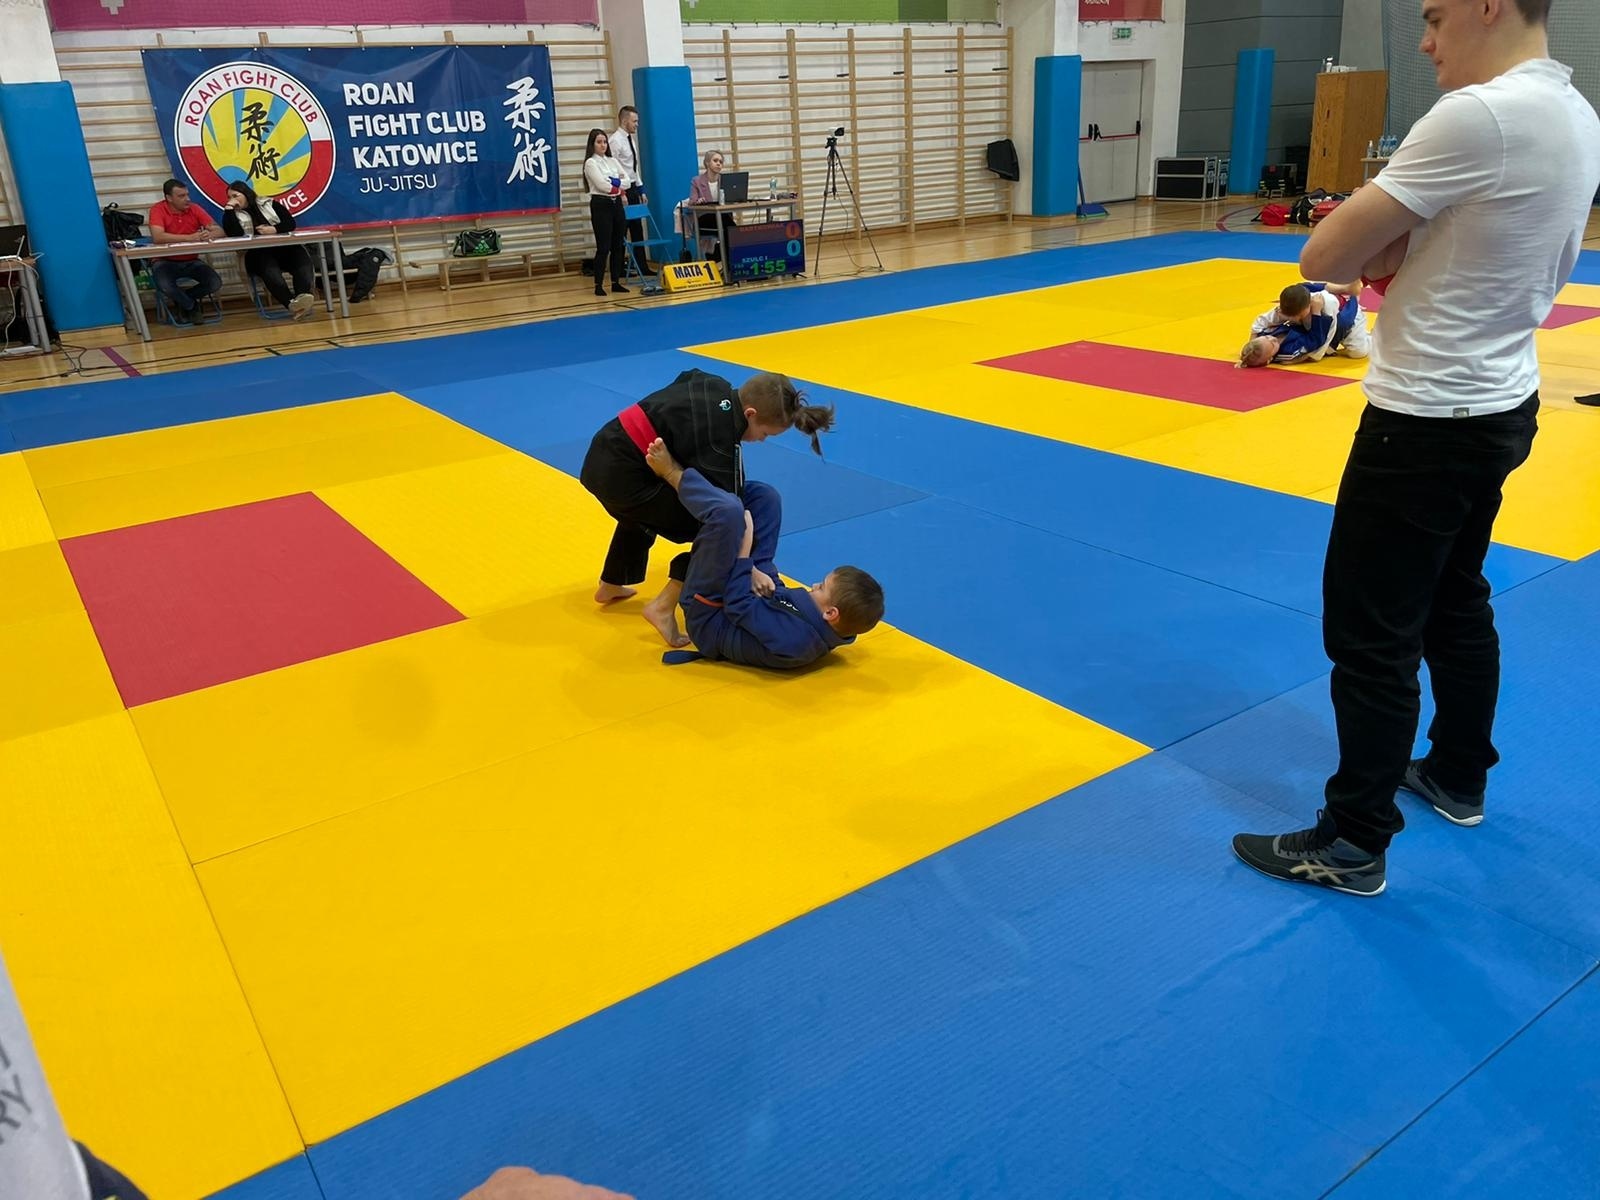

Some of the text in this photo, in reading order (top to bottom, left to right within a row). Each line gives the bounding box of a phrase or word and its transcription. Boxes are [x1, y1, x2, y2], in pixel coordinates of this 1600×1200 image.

[185, 70, 318, 126] ROAN FIGHT CLUB
[343, 82, 415, 106] ROAN
[348, 111, 486, 138] FIGHT CLUB
[352, 141, 479, 169] KATOWICE
[360, 174, 437, 194] JU-JITSU
[785, 221, 800, 240] 0
[786, 239, 801, 257] 0
[673, 264, 704, 279] MATA
[703, 262, 715, 281] 1
[750, 259, 786, 275] 1:55
